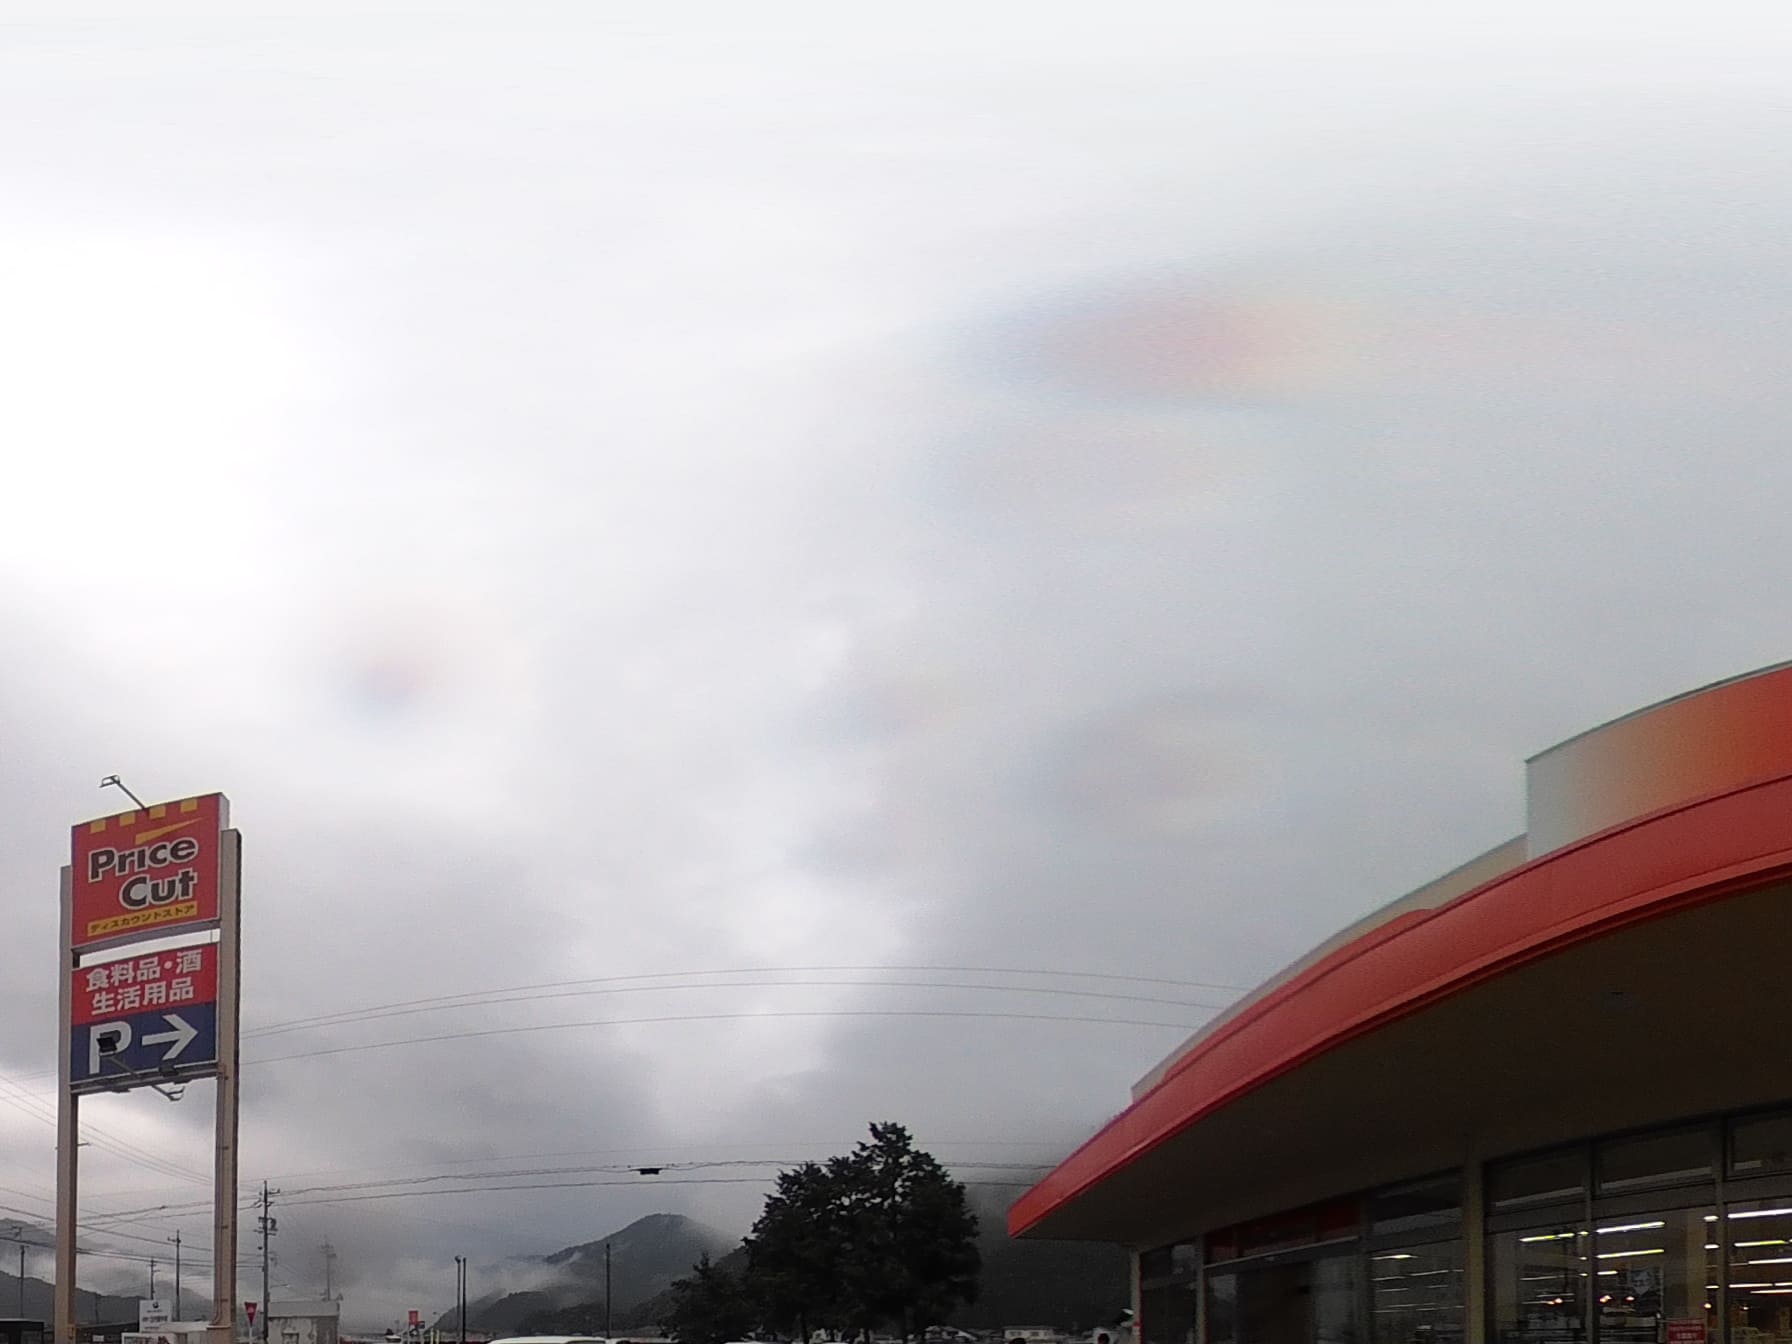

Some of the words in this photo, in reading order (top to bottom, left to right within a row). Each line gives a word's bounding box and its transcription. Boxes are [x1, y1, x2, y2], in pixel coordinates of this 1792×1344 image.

[88, 838, 198, 882] Price
[119, 868, 198, 910] Cut
[90, 904, 196, 933] ディスカウントストア
[86, 949, 202, 993] 食料品・酒
[91, 976, 194, 1016] 生活用品
[89, 1020, 132, 1075] P
